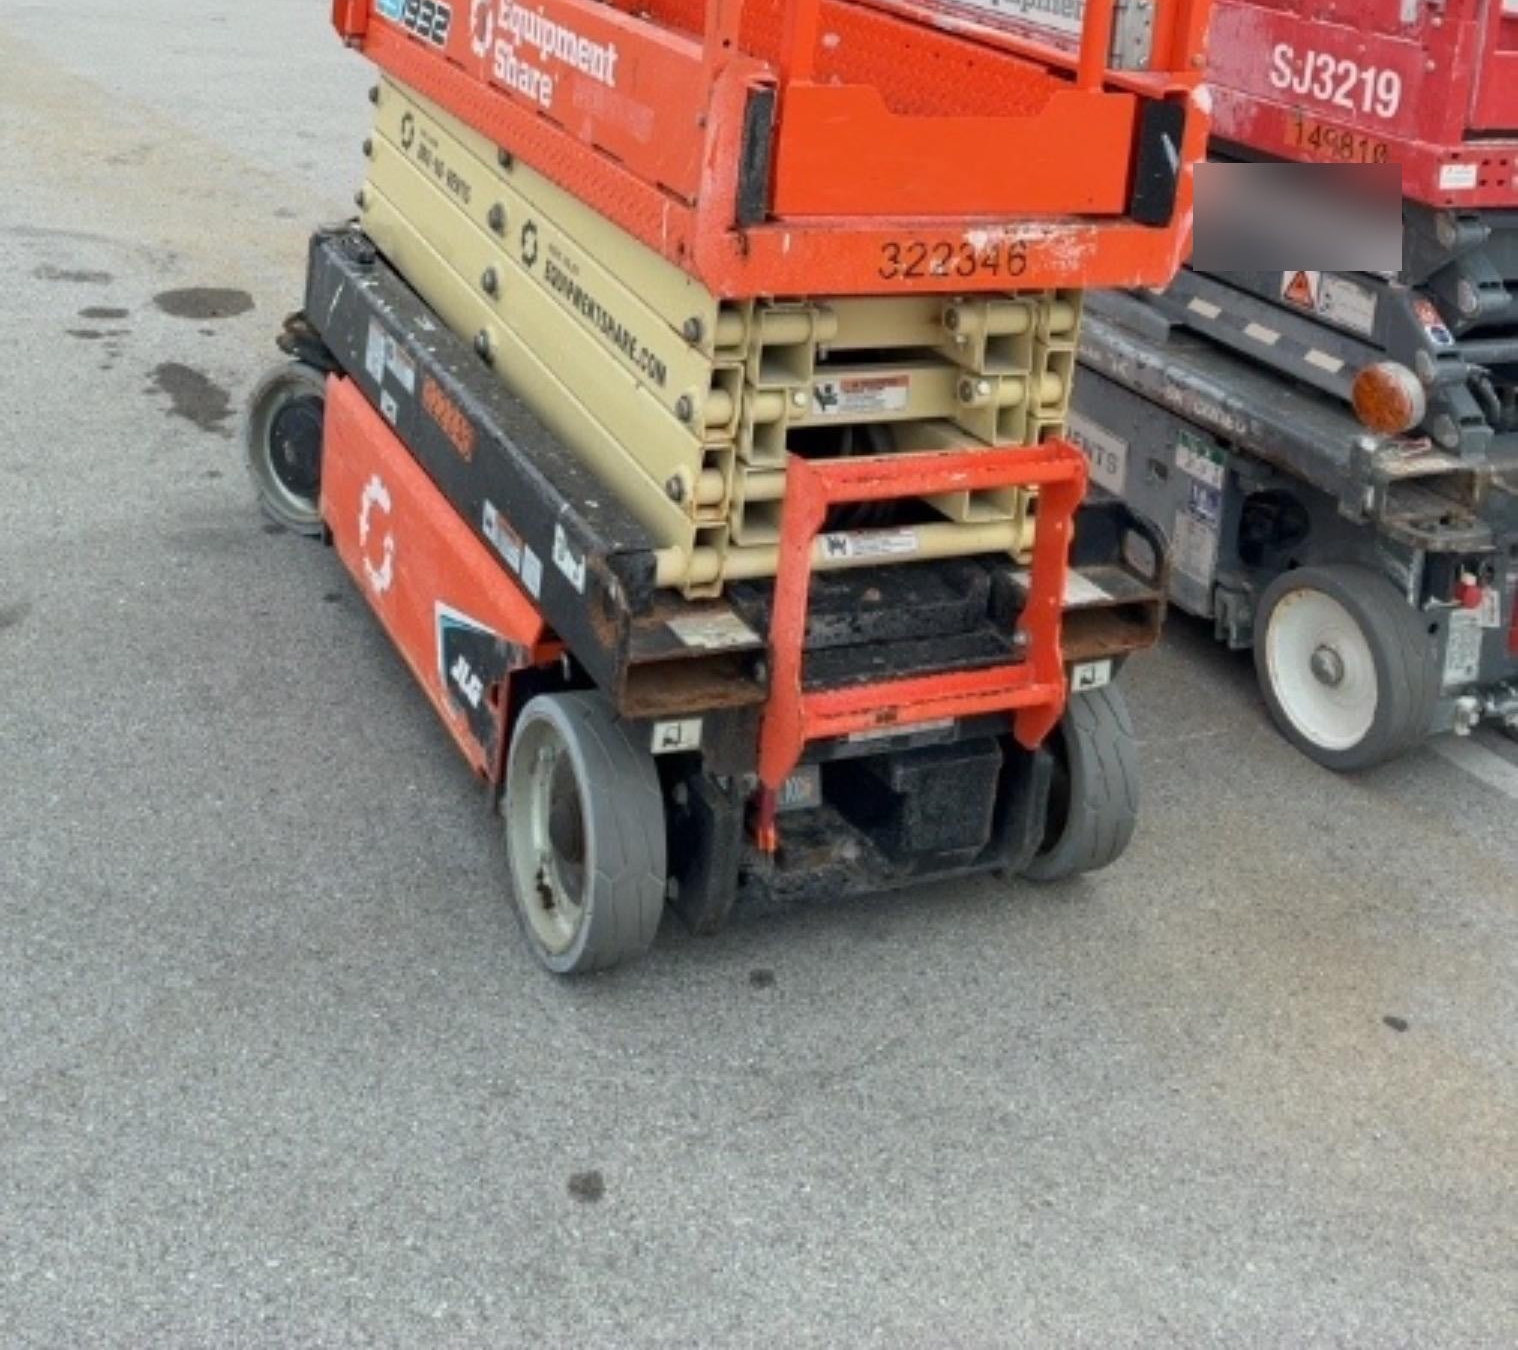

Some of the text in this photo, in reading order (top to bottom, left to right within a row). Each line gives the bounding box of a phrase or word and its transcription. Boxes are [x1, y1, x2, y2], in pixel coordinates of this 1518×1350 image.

[494, 38, 553, 108] Share
[1270, 43, 1400, 118] SJ3219
[878, 240, 1027, 279] 322346
